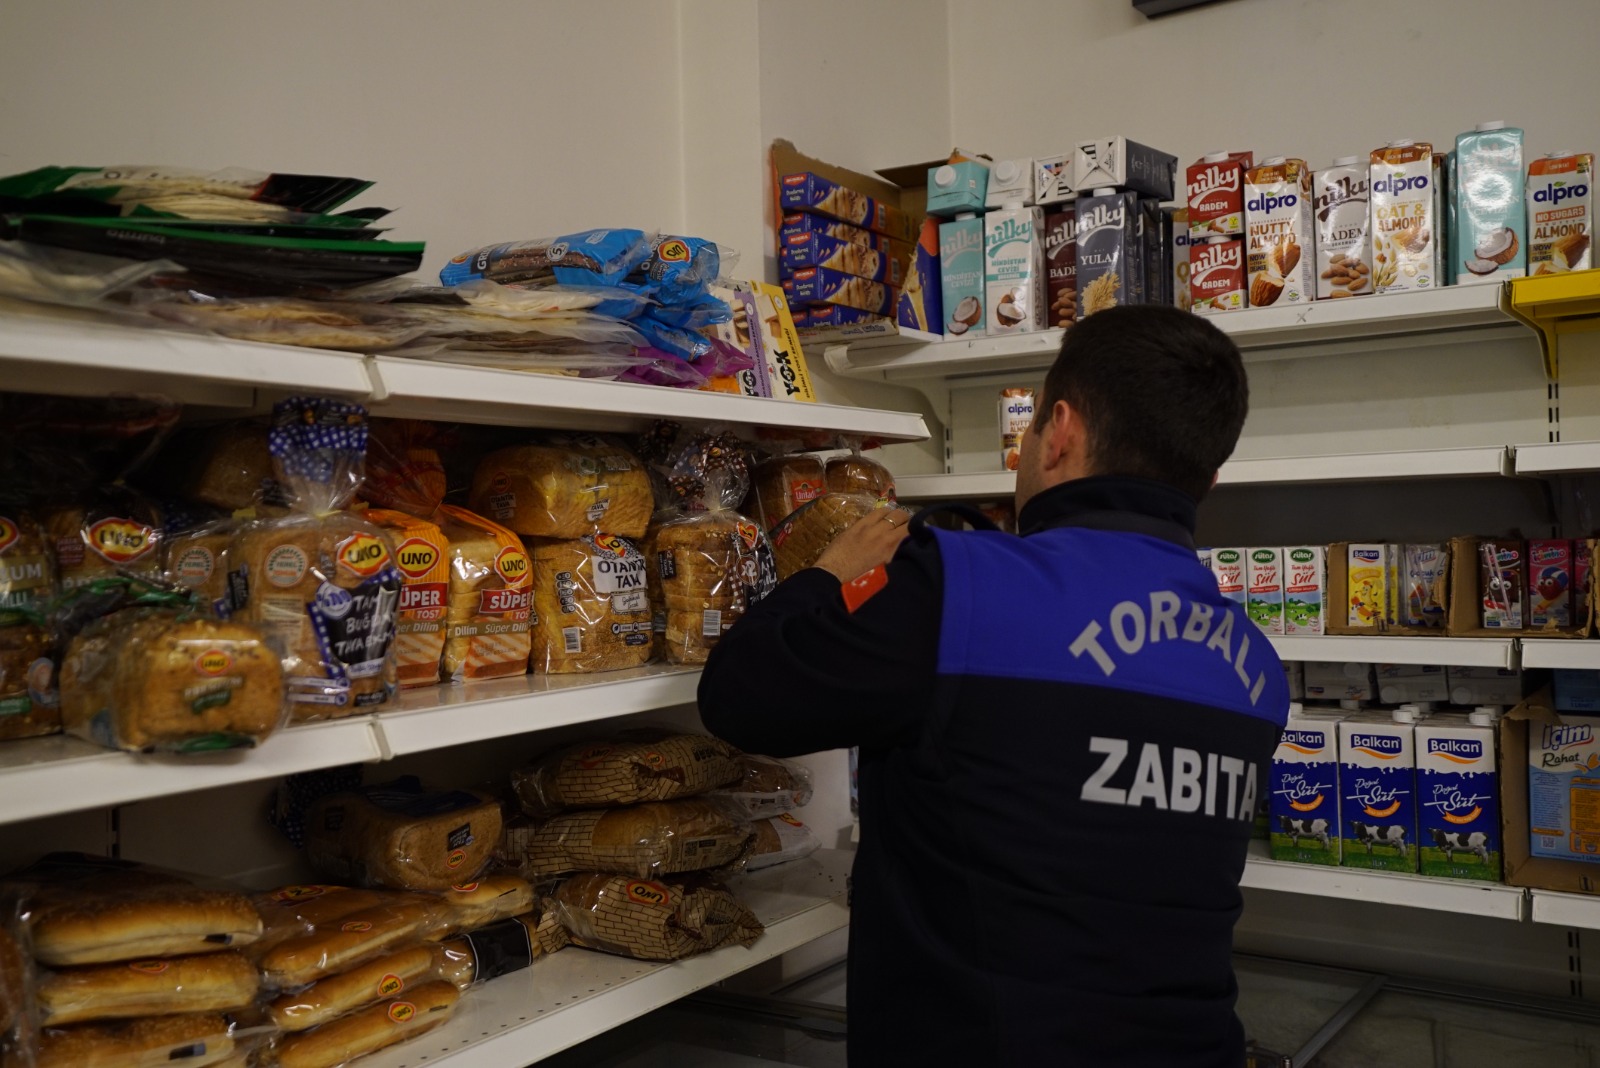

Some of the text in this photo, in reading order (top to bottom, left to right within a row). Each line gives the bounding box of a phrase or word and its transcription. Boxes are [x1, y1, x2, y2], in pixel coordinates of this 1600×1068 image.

[1374, 173, 1428, 196] alpro
[1533, 184, 1588, 204] alpro
[1199, 201, 1228, 212] BADEM
[1247, 193, 1297, 214] alpro
[1376, 203, 1426, 219] OAT &
[1536, 207, 1585, 221] NO SUGARS
[1250, 221, 1295, 236] NUTTY
[1379, 216, 1426, 232] ALMOND
[1534, 223, 1586, 239] ALMOND
[1250, 233, 1297, 249] ALMOND
[1202, 279, 1230, 290] BADEM
[1008, 403, 1032, 415] alpro
[348, 543, 382, 564] UNO
[401, 552, 432, 565] UNO
[502, 560, 525, 572] UNO
[1253, 572, 1276, 586] Süt
[1291, 571, 1316, 585] Süt
[400, 588, 440, 607] ÜPER
[416, 610, 440, 619] TOST
[515, 611, 529, 619] TOS
[412, 622, 439, 632] Dilim
[1068, 590, 1266, 707] TORBALI
[1353, 736, 1400, 749] Balkan
[1431, 739, 1480, 753] Balkan
[1542, 752, 1580, 767] Rahat
[1080, 736, 1257, 822] ZABITA
[1285, 780, 1327, 799] Süt
[1358, 785, 1403, 805] Süt
[1436, 791, 1484, 811] Süt
[634, 886, 663, 903] UNO
